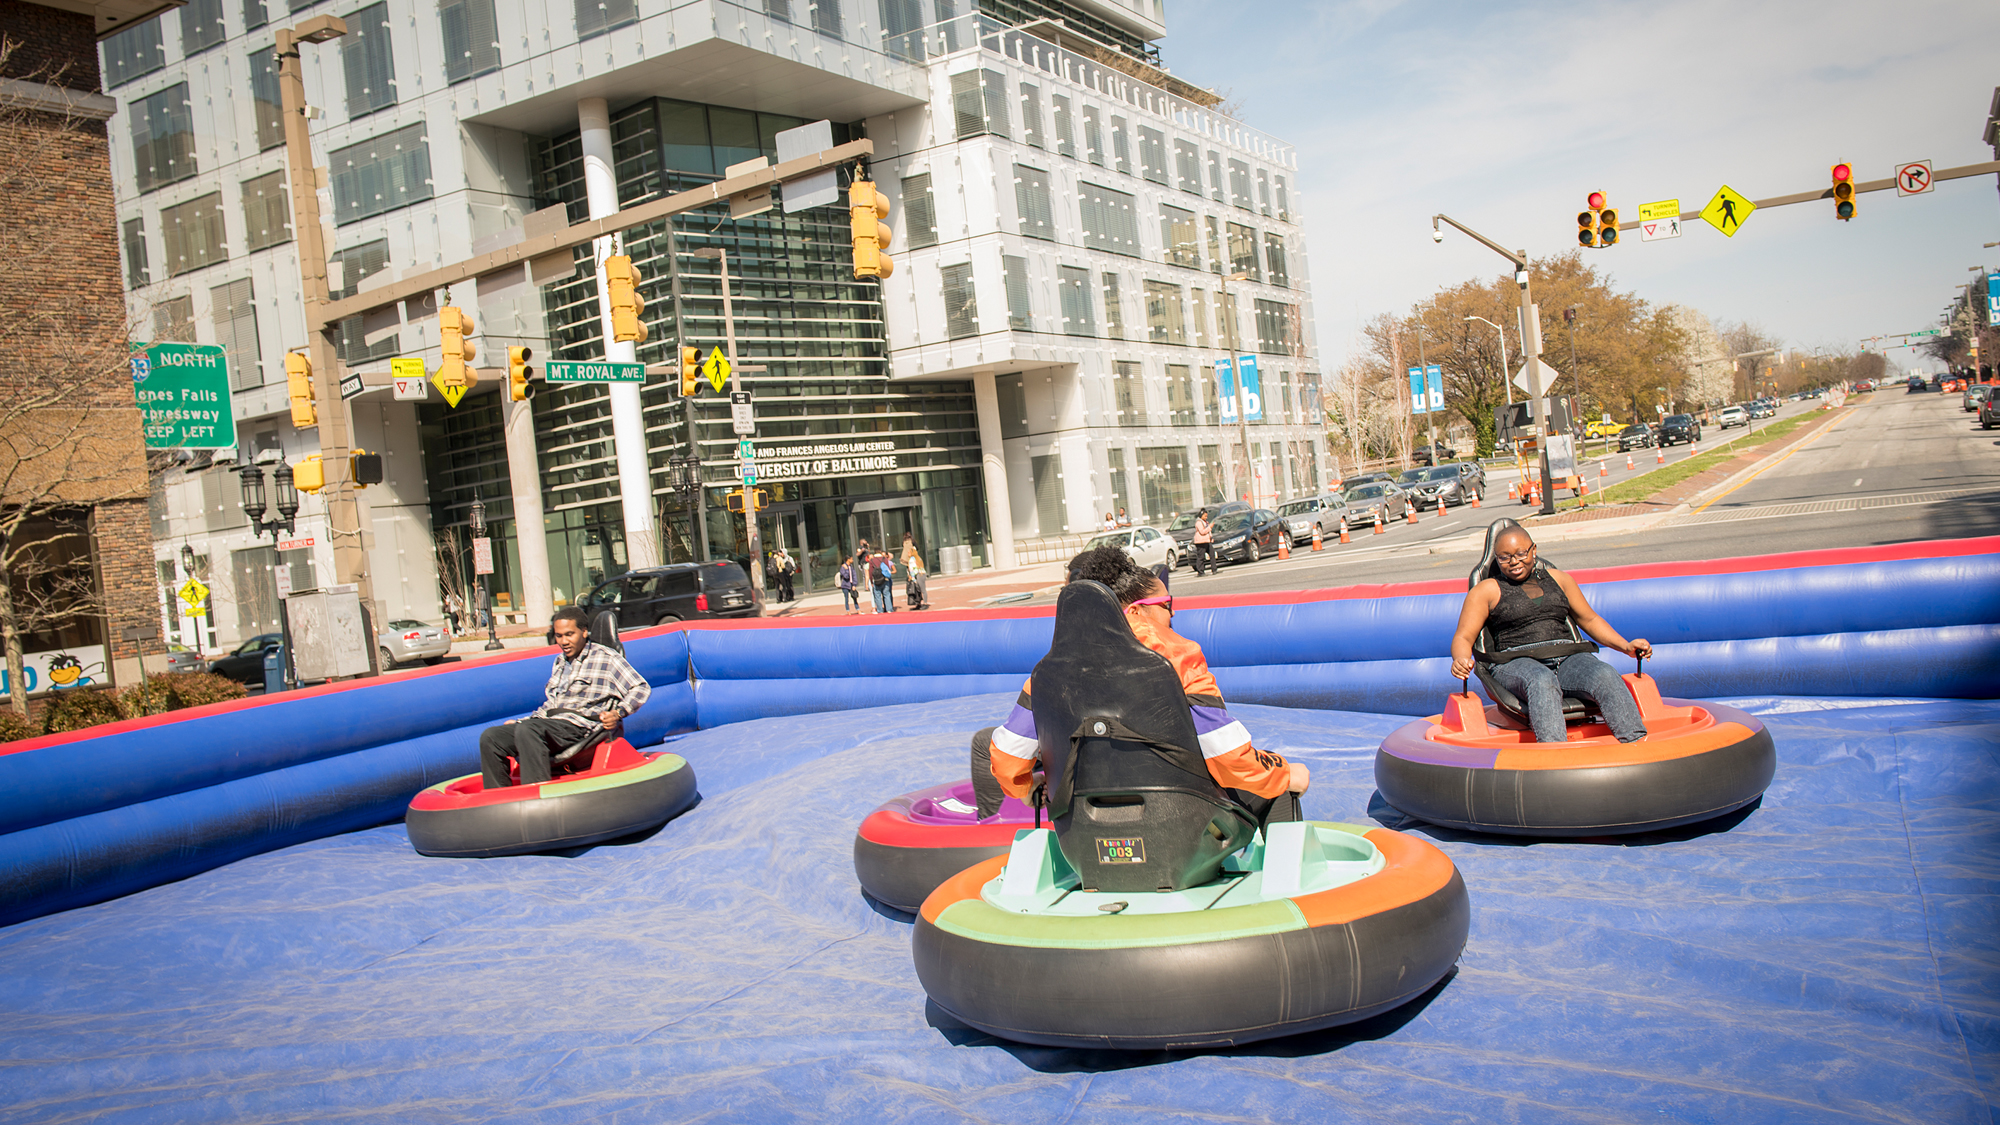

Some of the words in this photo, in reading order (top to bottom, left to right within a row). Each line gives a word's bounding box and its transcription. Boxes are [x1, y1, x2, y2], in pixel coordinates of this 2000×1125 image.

[1653, 202, 1677, 210] TURNING
[1653, 209, 1679, 217] VEHICLES
[160, 352, 216, 368] NORTH
[551, 364, 573, 379] MT.
[577, 365, 617, 379] ROYAL
[621, 367, 643, 379] AVE.
[342, 380, 357, 393] WAY
[134, 390, 174, 401] ones
[181, 388, 218, 402] Falls
[1412, 387, 1444, 410] ub
[141, 409, 219, 423] xpressway
[144, 425, 175, 438] EEP
[181, 425, 215, 438] LEFT
[757, 447, 775, 458] AND
[776, 445, 813, 457] FRANCES
[813, 443, 849, 454] ANGELOS
[849, 442, 866, 453] LAW
[865, 441, 895, 452] CENTER
[733, 461, 810, 480] UIVERSITY
[813, 460, 829, 473] OF
[831, 456, 898, 472] BALTIMORE
[1109, 847, 1133, 857] 003
